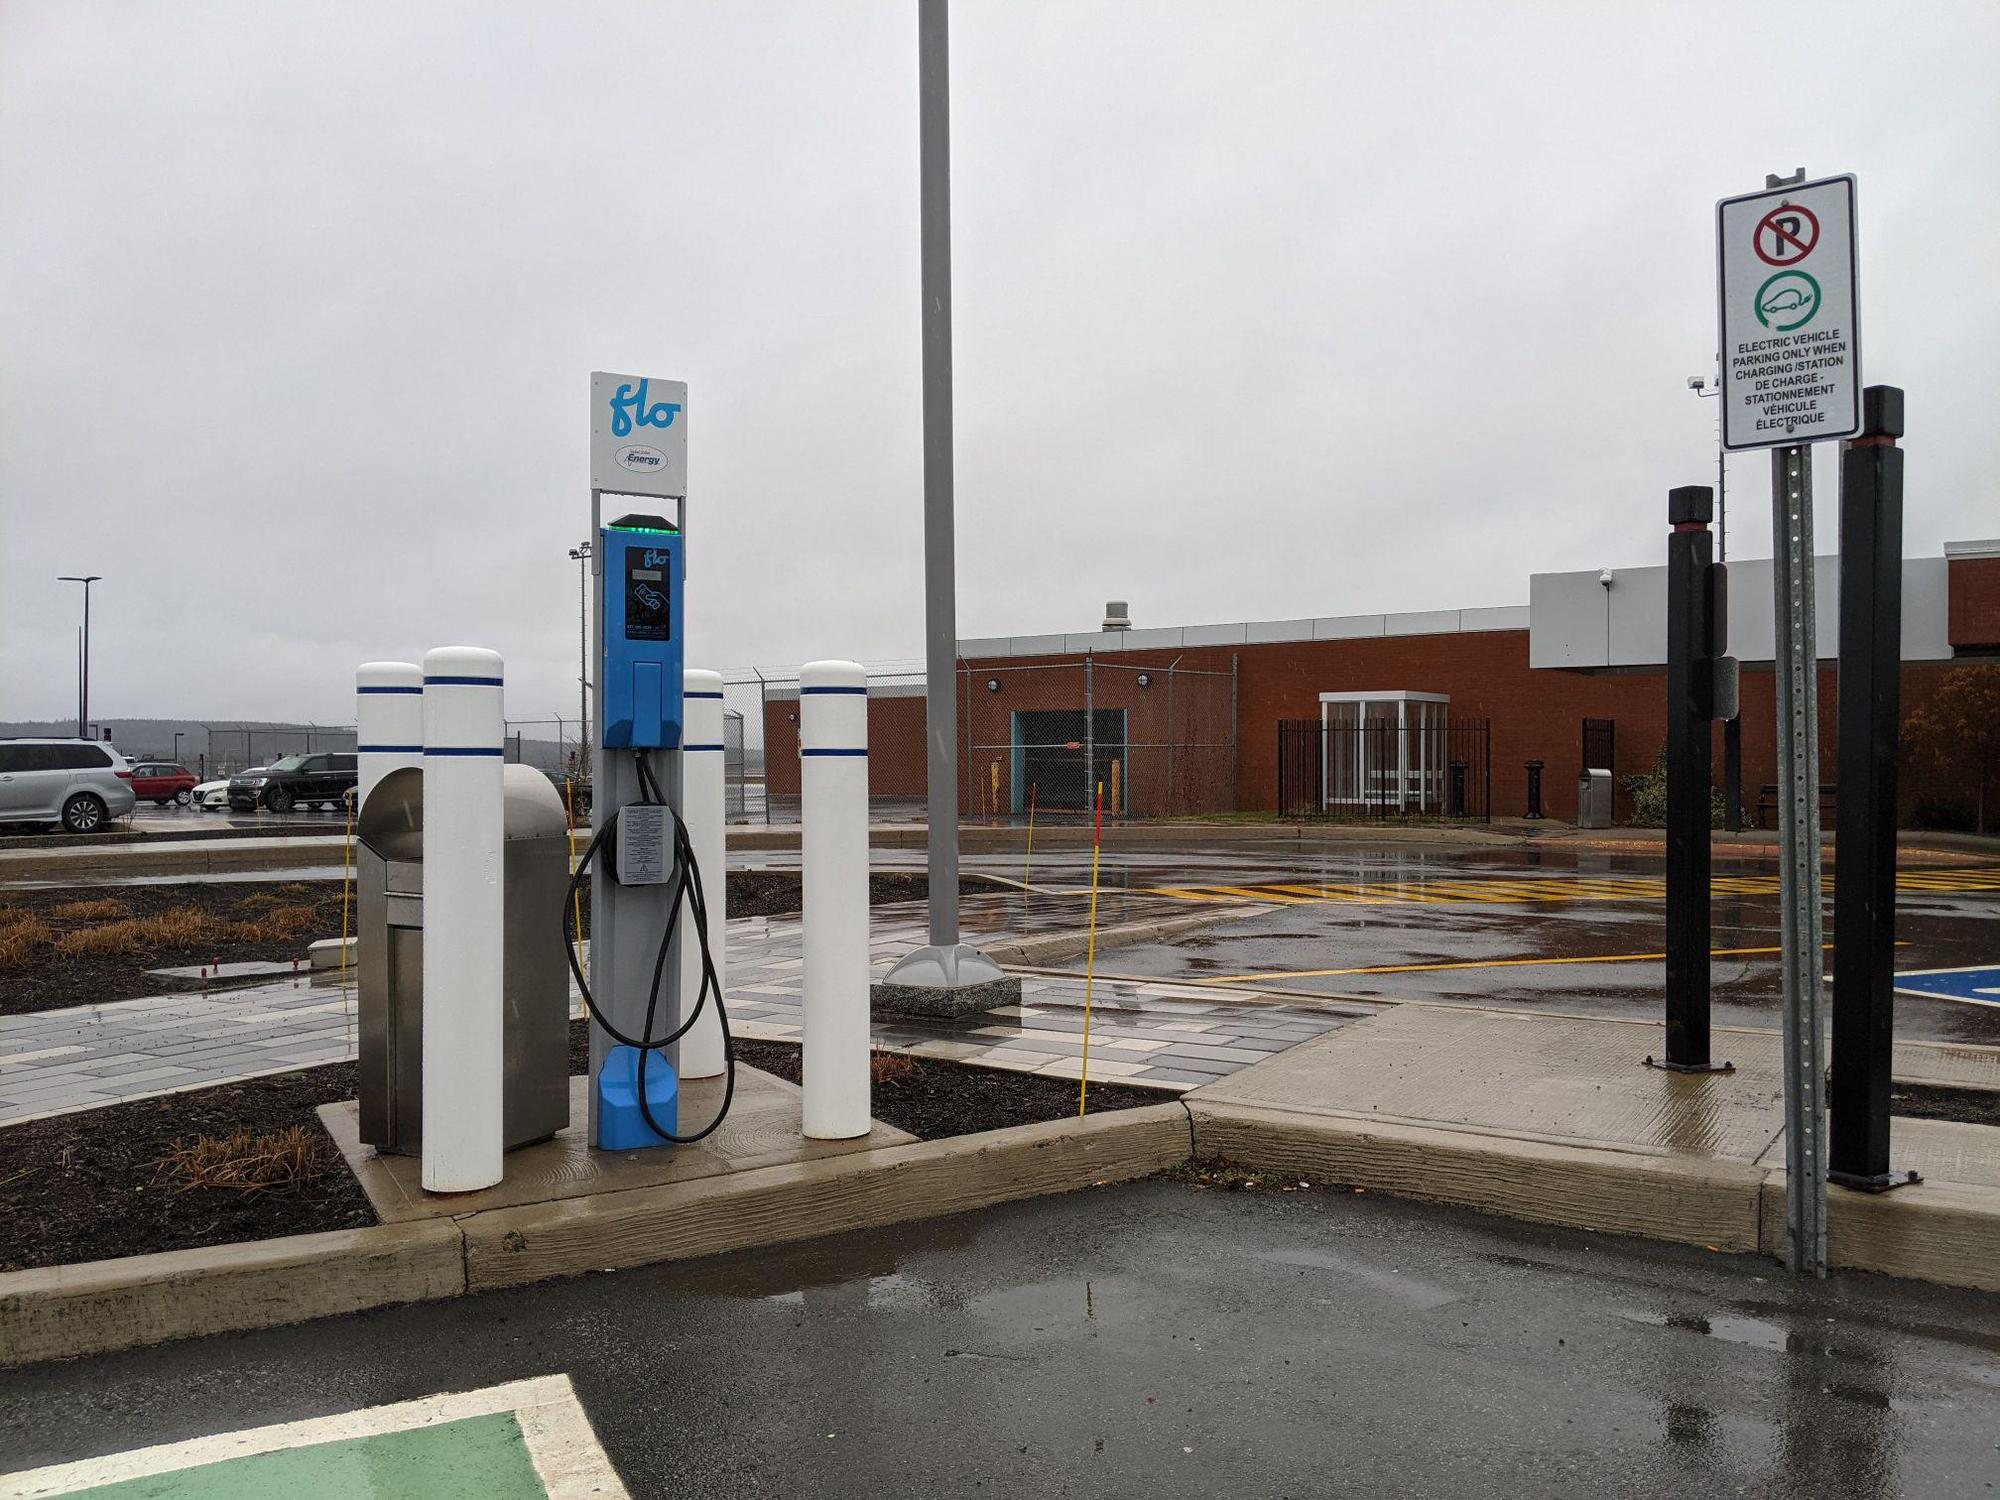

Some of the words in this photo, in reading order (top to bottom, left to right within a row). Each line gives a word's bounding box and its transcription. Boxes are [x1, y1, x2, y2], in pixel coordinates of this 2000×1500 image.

[1738, 336, 1791, 354] ELECTRIC
[1792, 329, 1840, 345] VEHICLE
[1733, 352, 1780, 368] PARKING
[1782, 347, 1811, 360] ONLY
[1812, 341, 1847, 355] WHEN
[1735, 363, 1793, 380] CHARGING
[1755, 379, 1770, 391] DE
[1772, 373, 1818, 388] CHARGE
[1745, 384, 1836, 406] STATIONNEMENT
[609, 378, 681, 437] flo
[1763, 400, 1817, 416] VÉHICULE
[1756, 412, 1825, 430] ÉLECTRIQUE
[628, 453, 660, 465] Energy
[644, 549, 669, 568] flo
